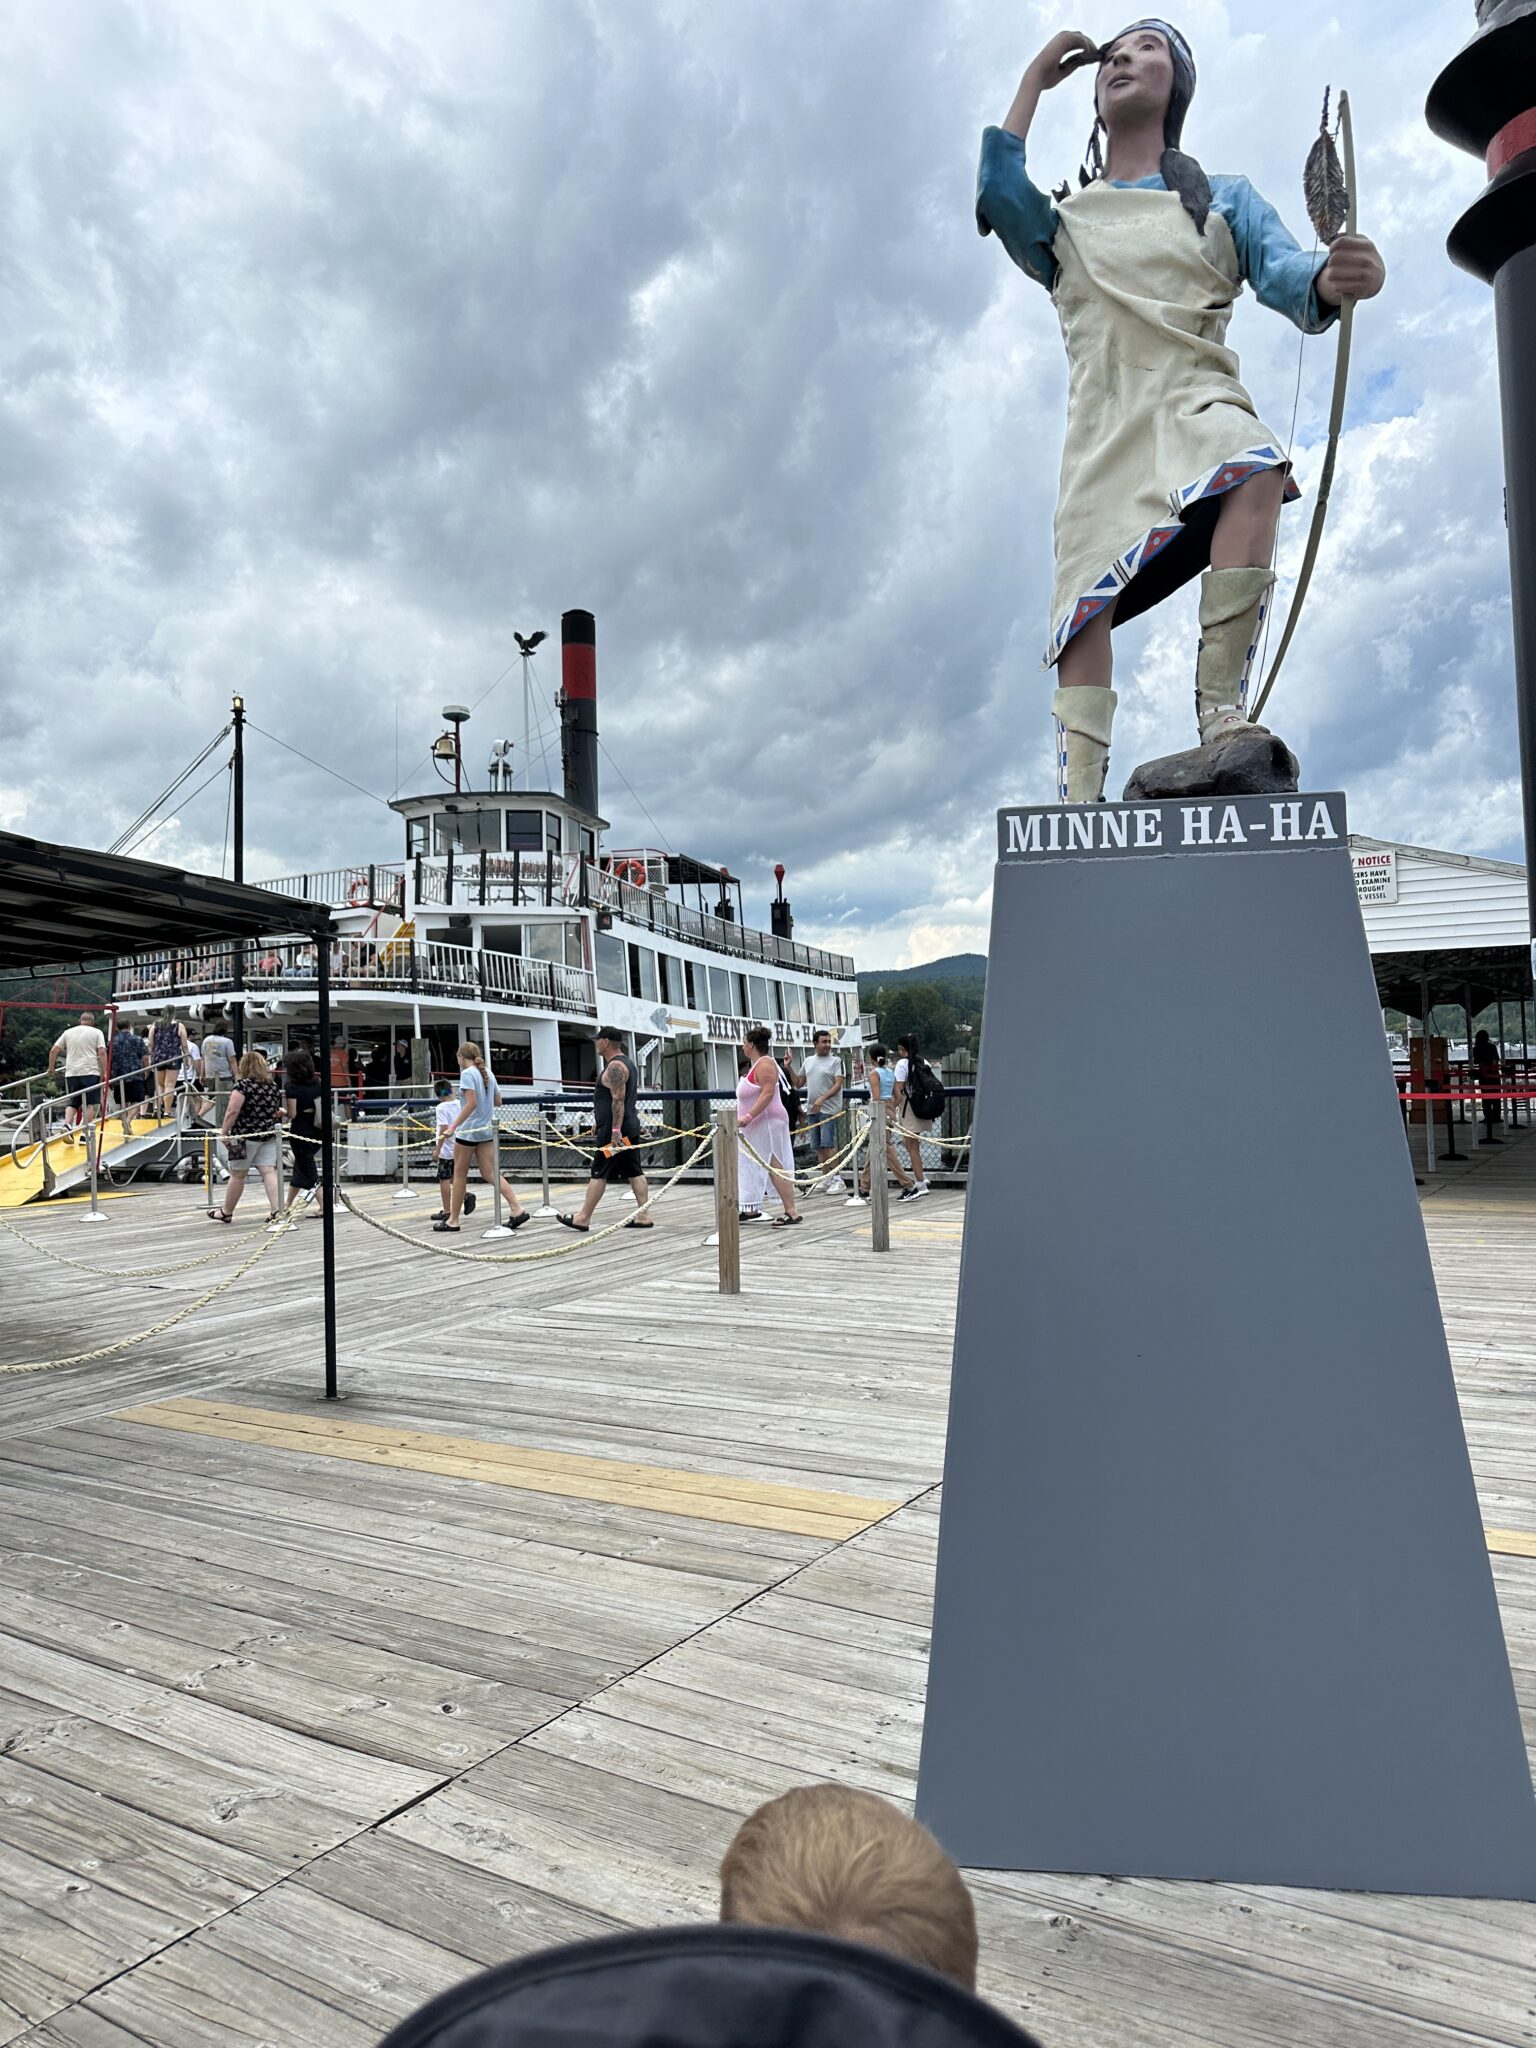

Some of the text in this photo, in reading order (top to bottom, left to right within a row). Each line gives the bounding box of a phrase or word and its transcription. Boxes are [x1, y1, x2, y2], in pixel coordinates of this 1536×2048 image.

[1006, 801, 1338, 853] MINNE HA-HA
[1358, 855, 1391, 866] NOTICE
[1370, 869, 1387, 877] HAVE
[1362, 877, 1391, 885] EXAMINE
[1358, 885, 1385, 893] ROUGHT
[1364, 892, 1387, 900] VESSEL
